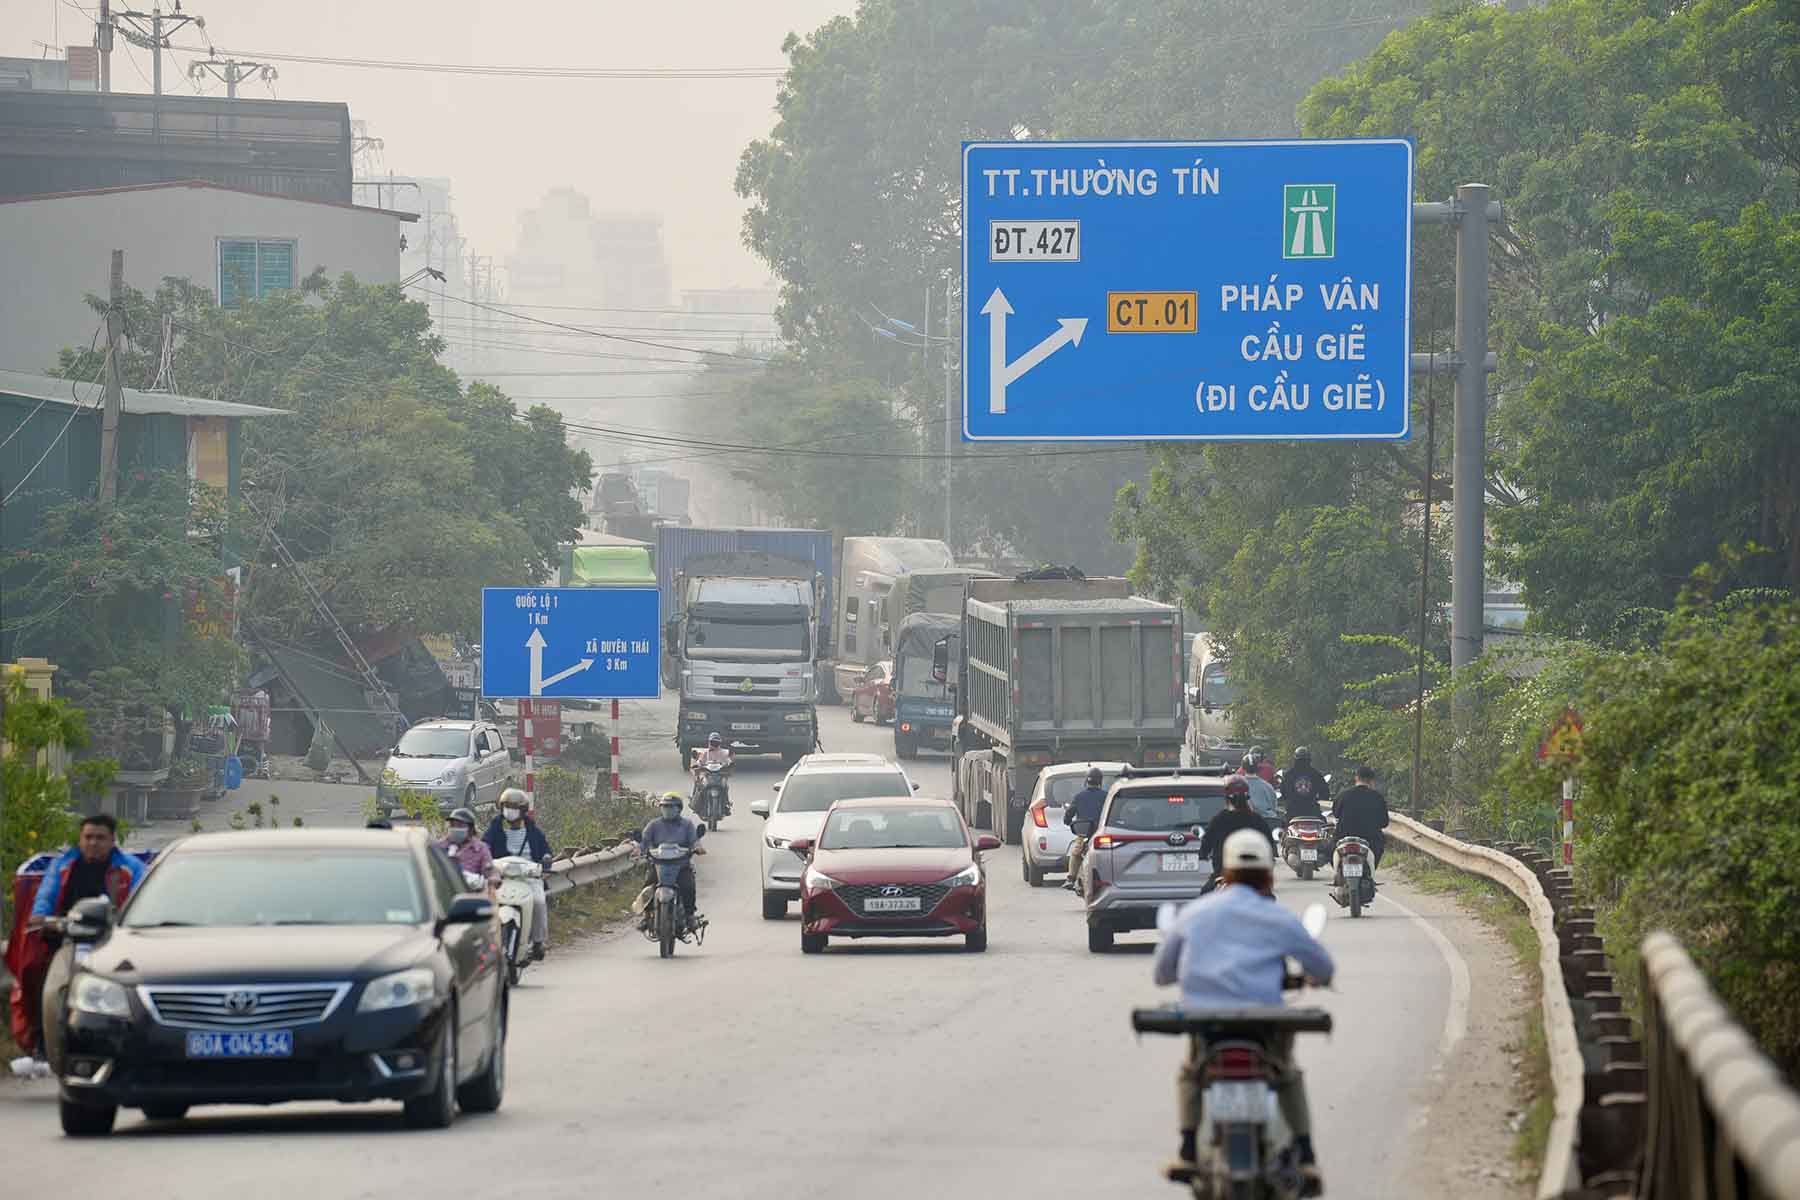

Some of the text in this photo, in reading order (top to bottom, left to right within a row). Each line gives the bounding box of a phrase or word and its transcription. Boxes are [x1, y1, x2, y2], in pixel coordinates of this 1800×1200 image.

[983, 158, 1220, 197] TT.THƯỜNG TÍN
[994, 227, 1076, 255] ĐT.427
[1221, 274, 1379, 312] PHÁP VÂN
[1116, 299, 1189, 326] CT.01
[1240, 321, 1366, 361] CẦU GIẼ
[1196, 370, 1385, 412] (ĐI CẦU GIẼ)
[515, 592, 558, 611] QUỐC LỘ 1
[528, 612, 548, 625] 1 Km
[585, 638, 598, 654] XÃ
[600, 638, 628, 654] DUYÊN
[606, 658, 628, 671] 3 Km
